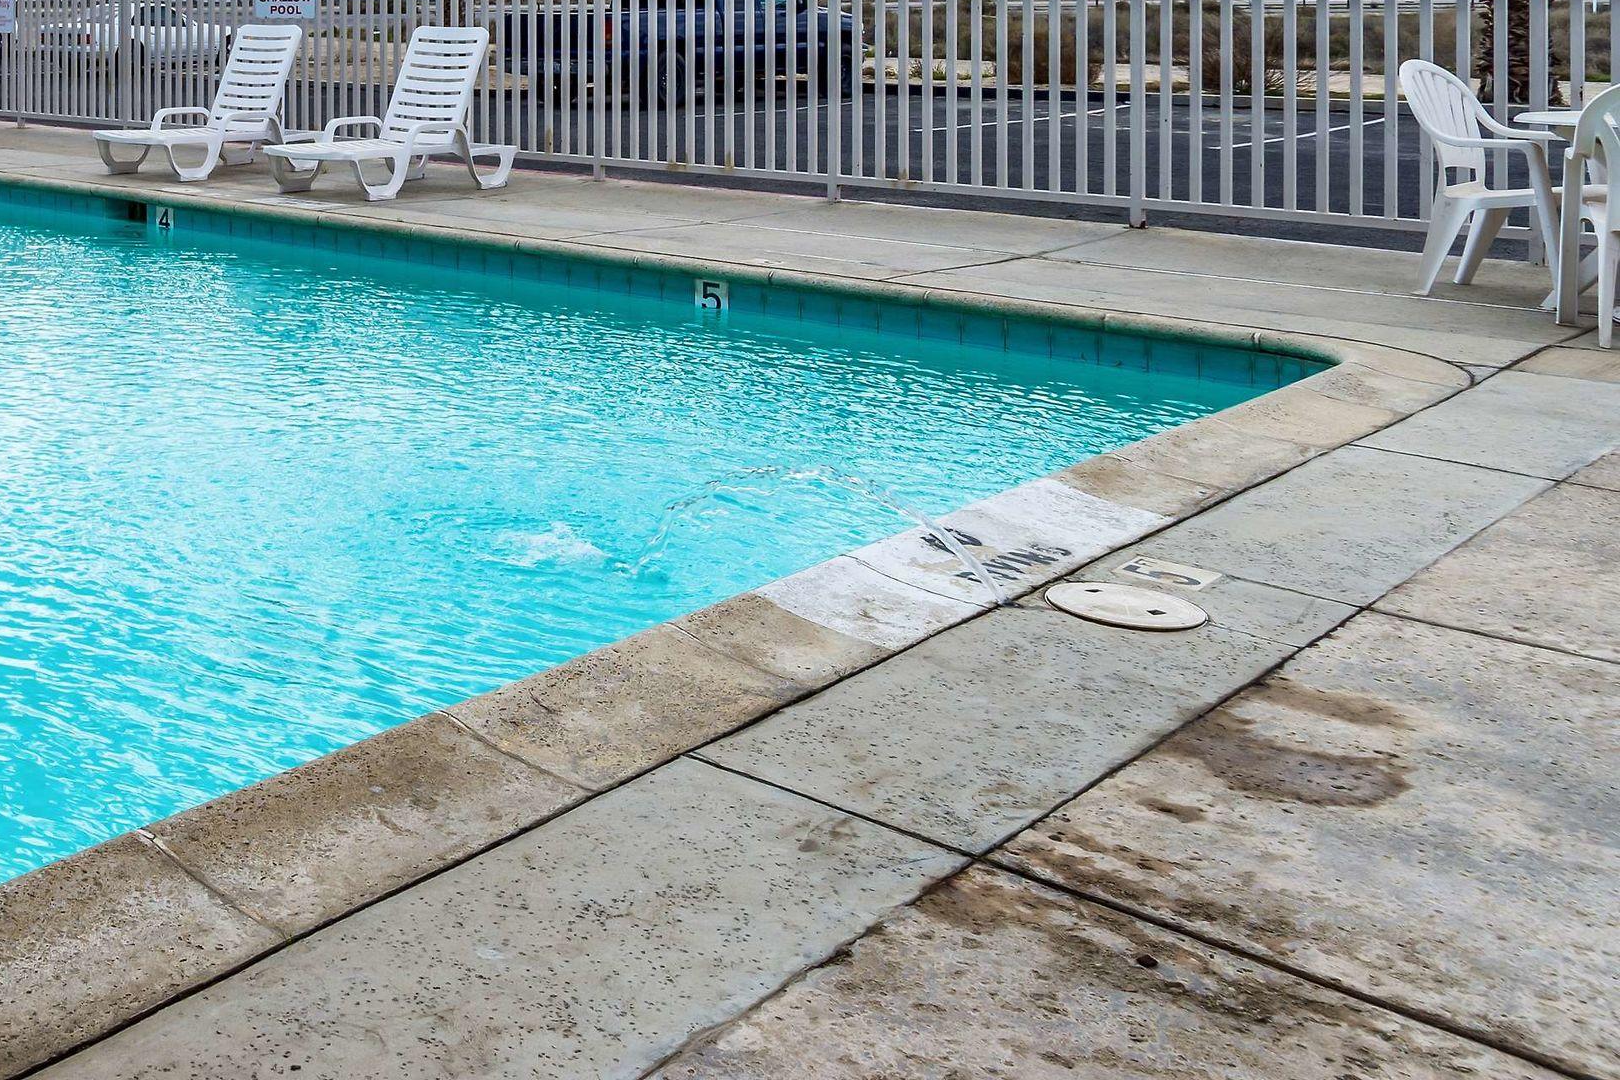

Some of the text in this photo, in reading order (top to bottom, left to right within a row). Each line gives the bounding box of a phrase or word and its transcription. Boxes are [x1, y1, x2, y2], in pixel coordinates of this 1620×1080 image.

[270, 5, 302, 14] POOL
[158, 208, 171, 228] 4
[702, 281, 722, 309] 5
